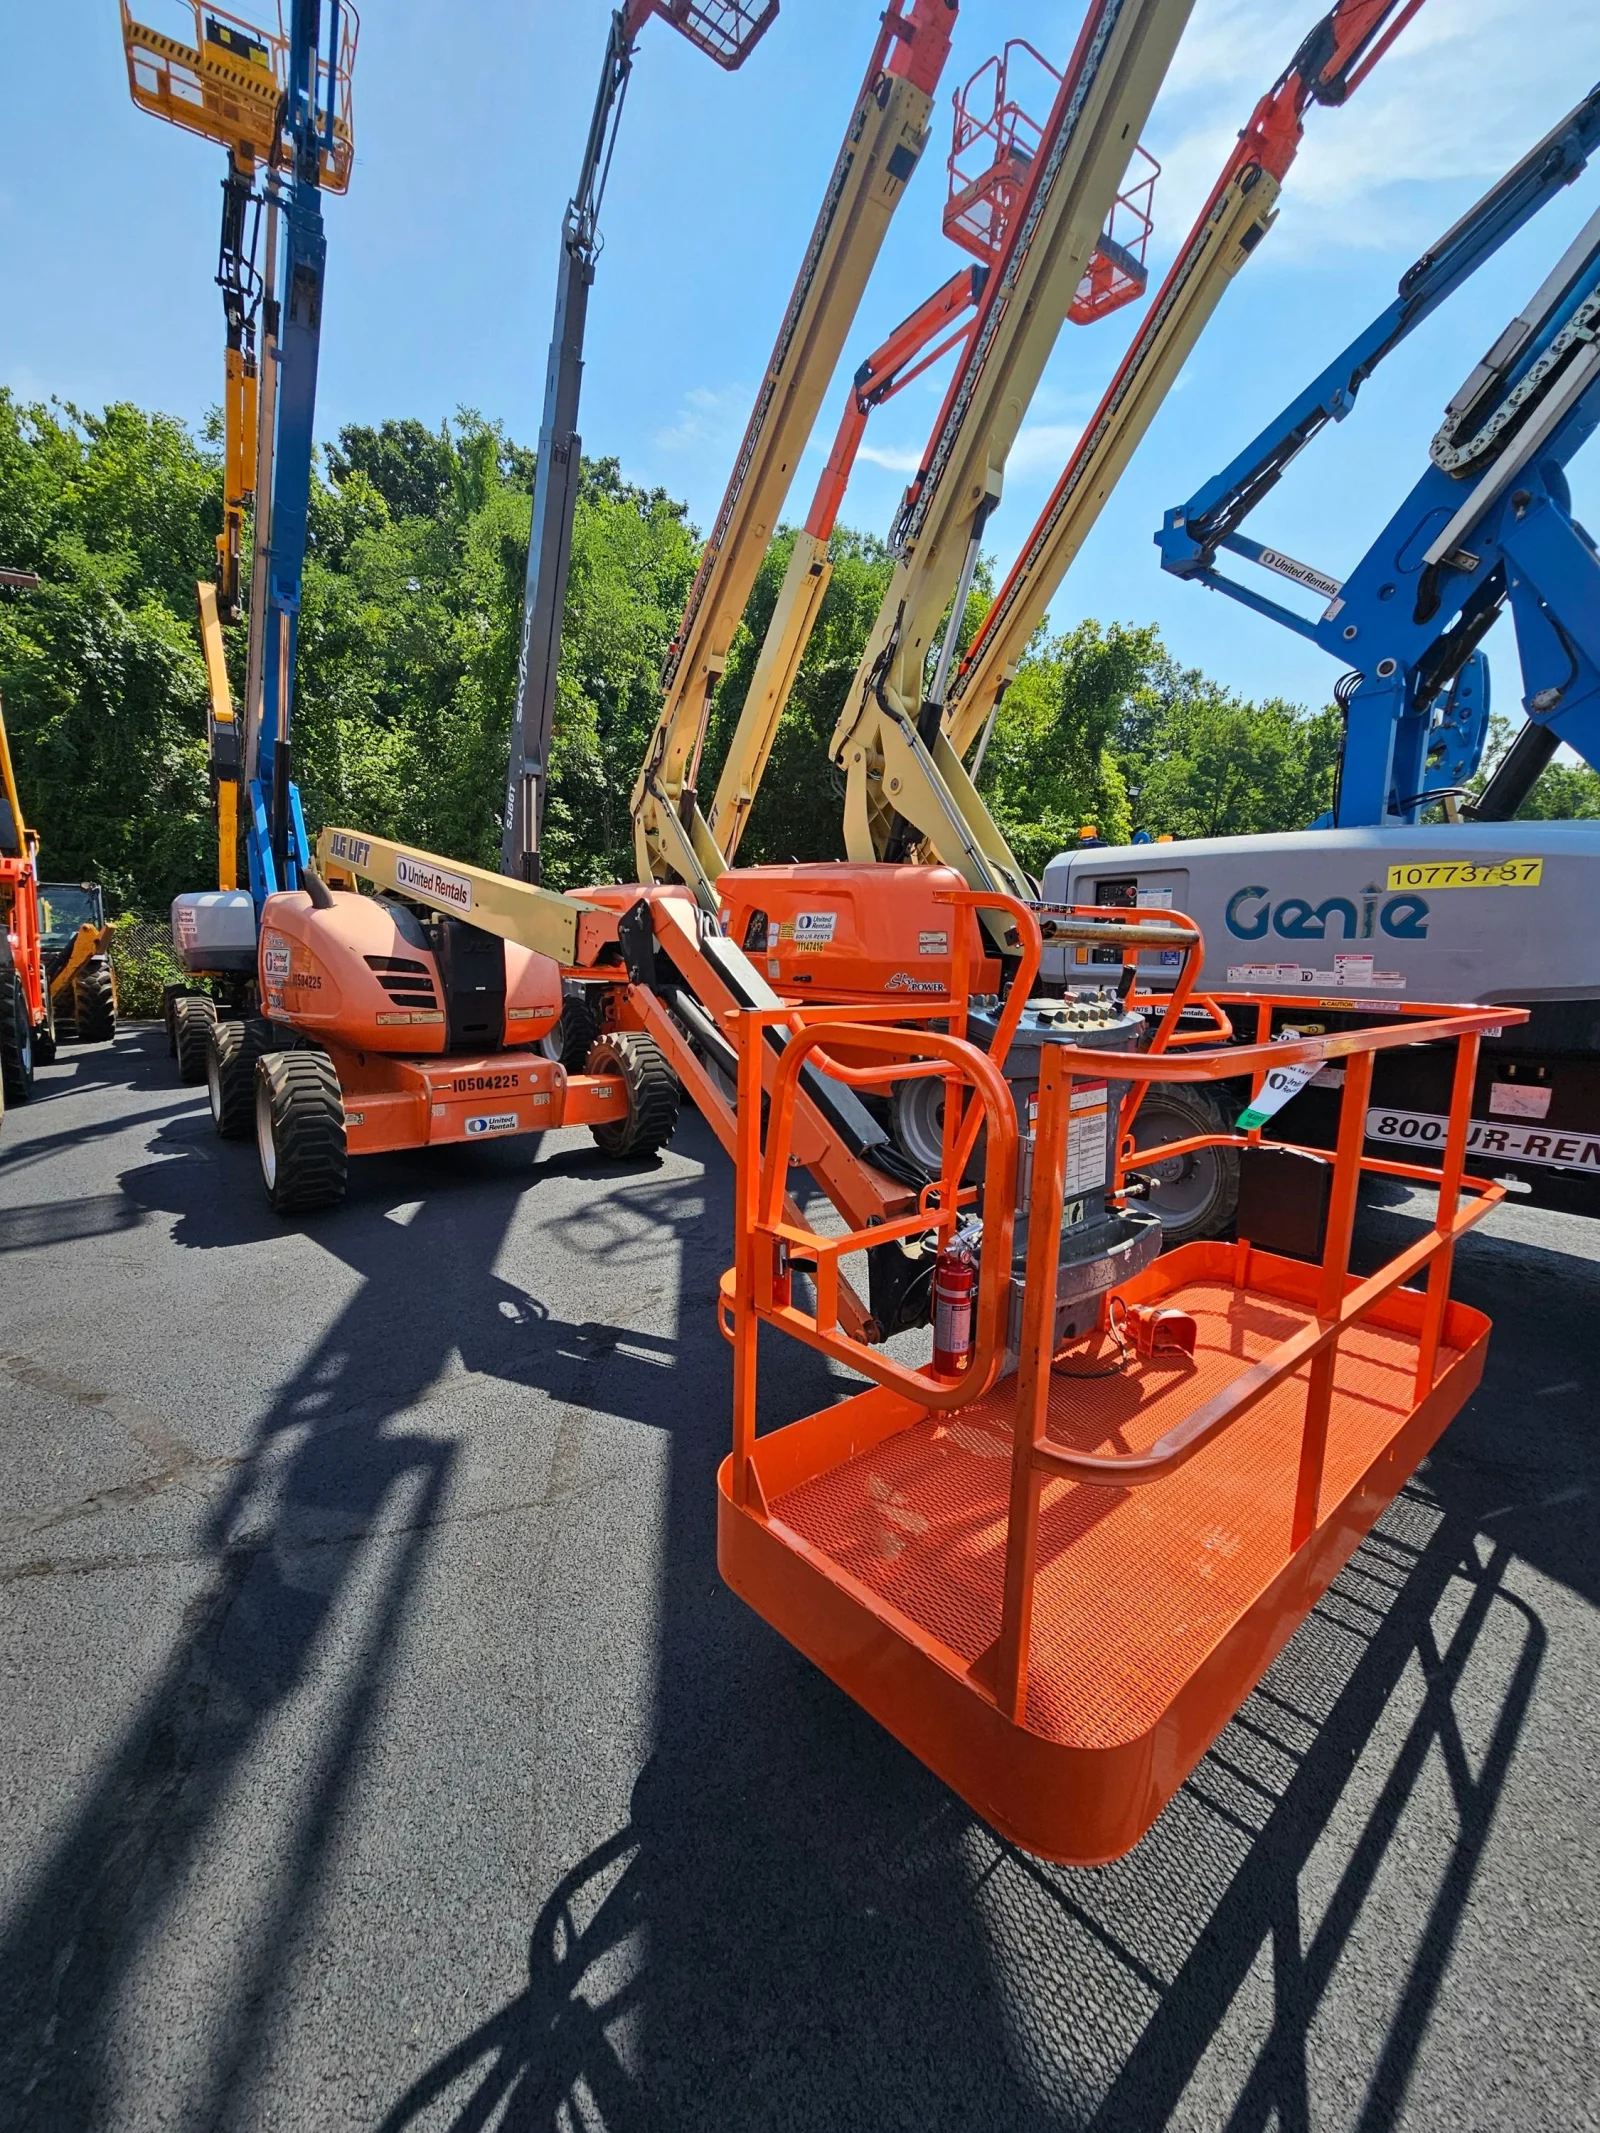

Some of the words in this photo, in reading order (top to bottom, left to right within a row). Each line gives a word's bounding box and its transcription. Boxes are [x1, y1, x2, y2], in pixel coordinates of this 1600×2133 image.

[1274, 557, 1306, 579] United
[1302, 572, 1338, 595] Rentals
[516, 604, 534, 724] SKYJACK
[330, 832, 347, 858] JLG
[347, 835, 372, 868] LIFT
[408, 865, 433, 891] United
[434, 875, 468, 904] Rentals
[1391, 863, 1540, 886] 10773787
[812, 915, 834, 923] United
[1224, 881, 1432, 941] Genie
[811, 922, 833, 930] Rentals
[273, 952, 288, 963] United
[452, 1073, 520, 1094] 10504225
[488, 1115, 514, 1125] United
[488, 1121, 516, 1132] Rentals
